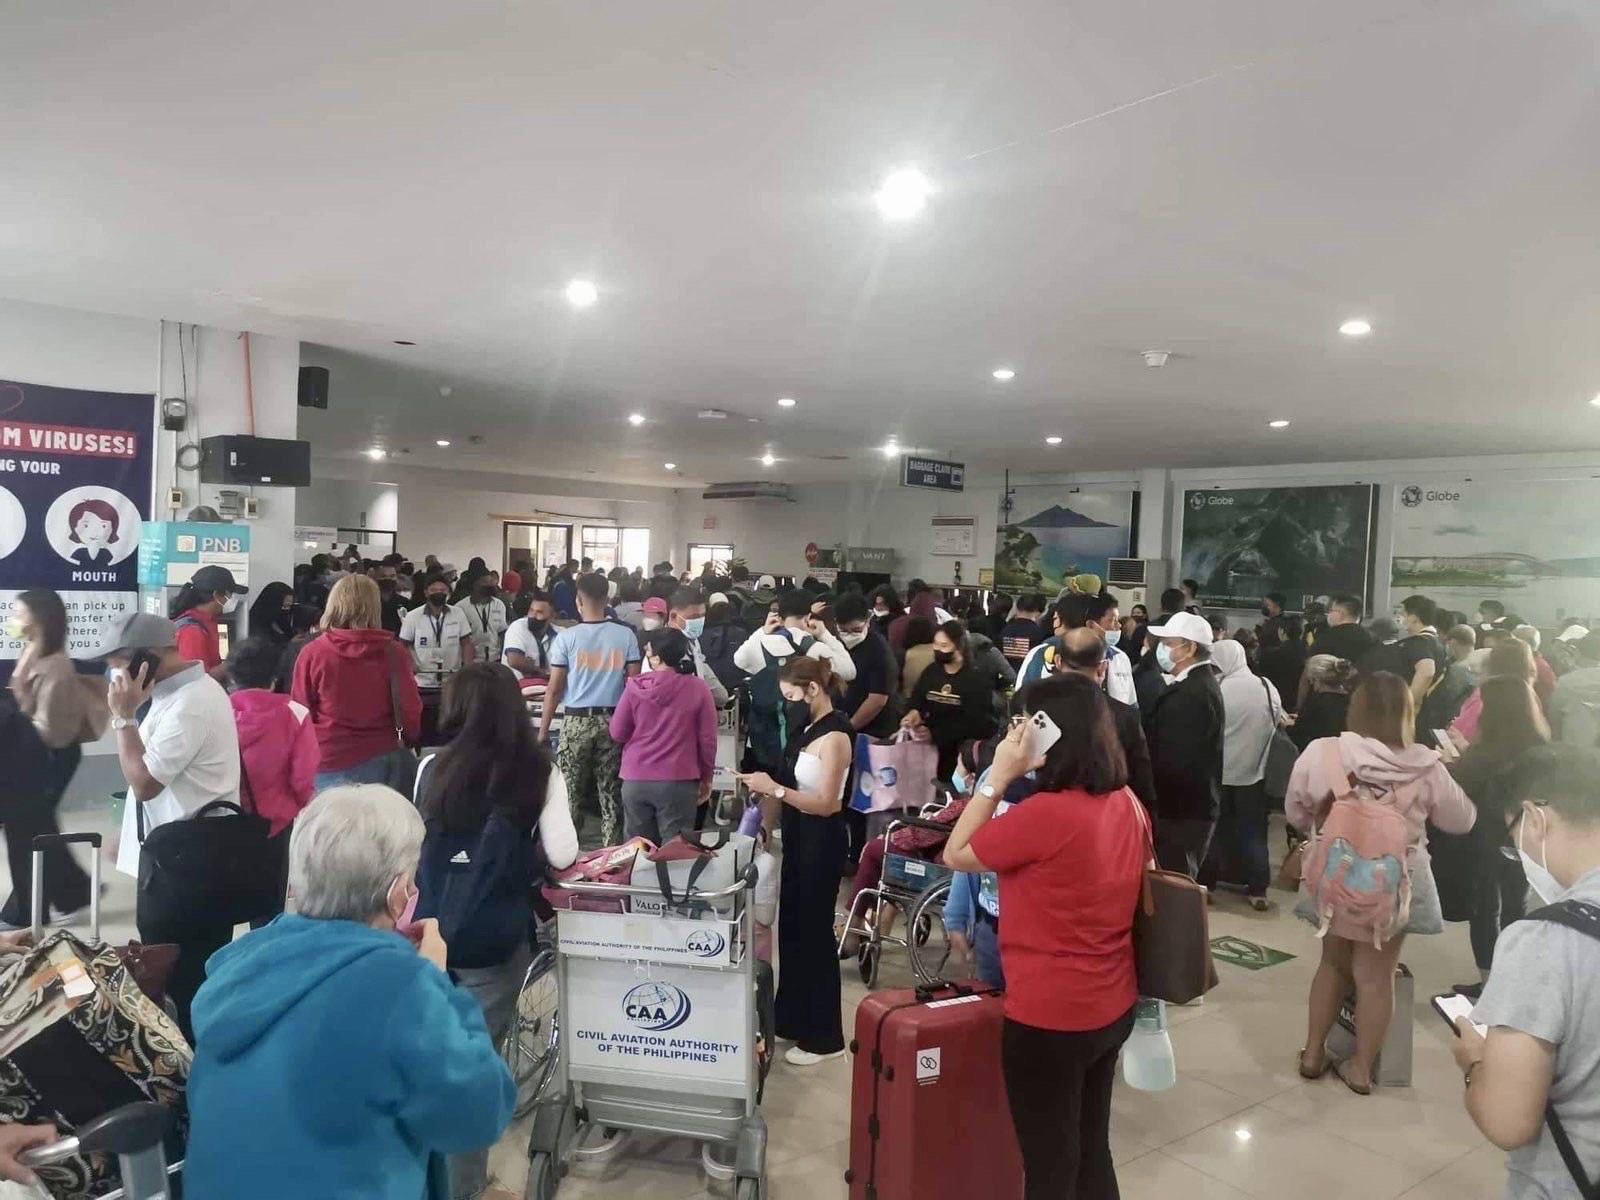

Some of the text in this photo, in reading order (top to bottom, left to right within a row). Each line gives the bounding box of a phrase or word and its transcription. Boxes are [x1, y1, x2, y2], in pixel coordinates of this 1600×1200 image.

[0, 427, 134, 455] M VIRUSES!
[20, 460, 60, 475] YOUR
[1207, 495, 1234, 506] Globe
[1426, 490, 1460, 502] Globe
[202, 537, 241, 552] PNB
[72, 571, 117, 583] MOUTH
[84, 601, 107, 611] pick
[111, 602, 126, 611] up
[70, 641, 90, 650] you
[688, 942, 712, 952] CAA
[626, 1004, 667, 1021] CAA
[576, 1030, 739, 1054] CIVIL AVIATION AUTHORITY
[598, 1043, 717, 1063] OF THE PHILIPPINES
